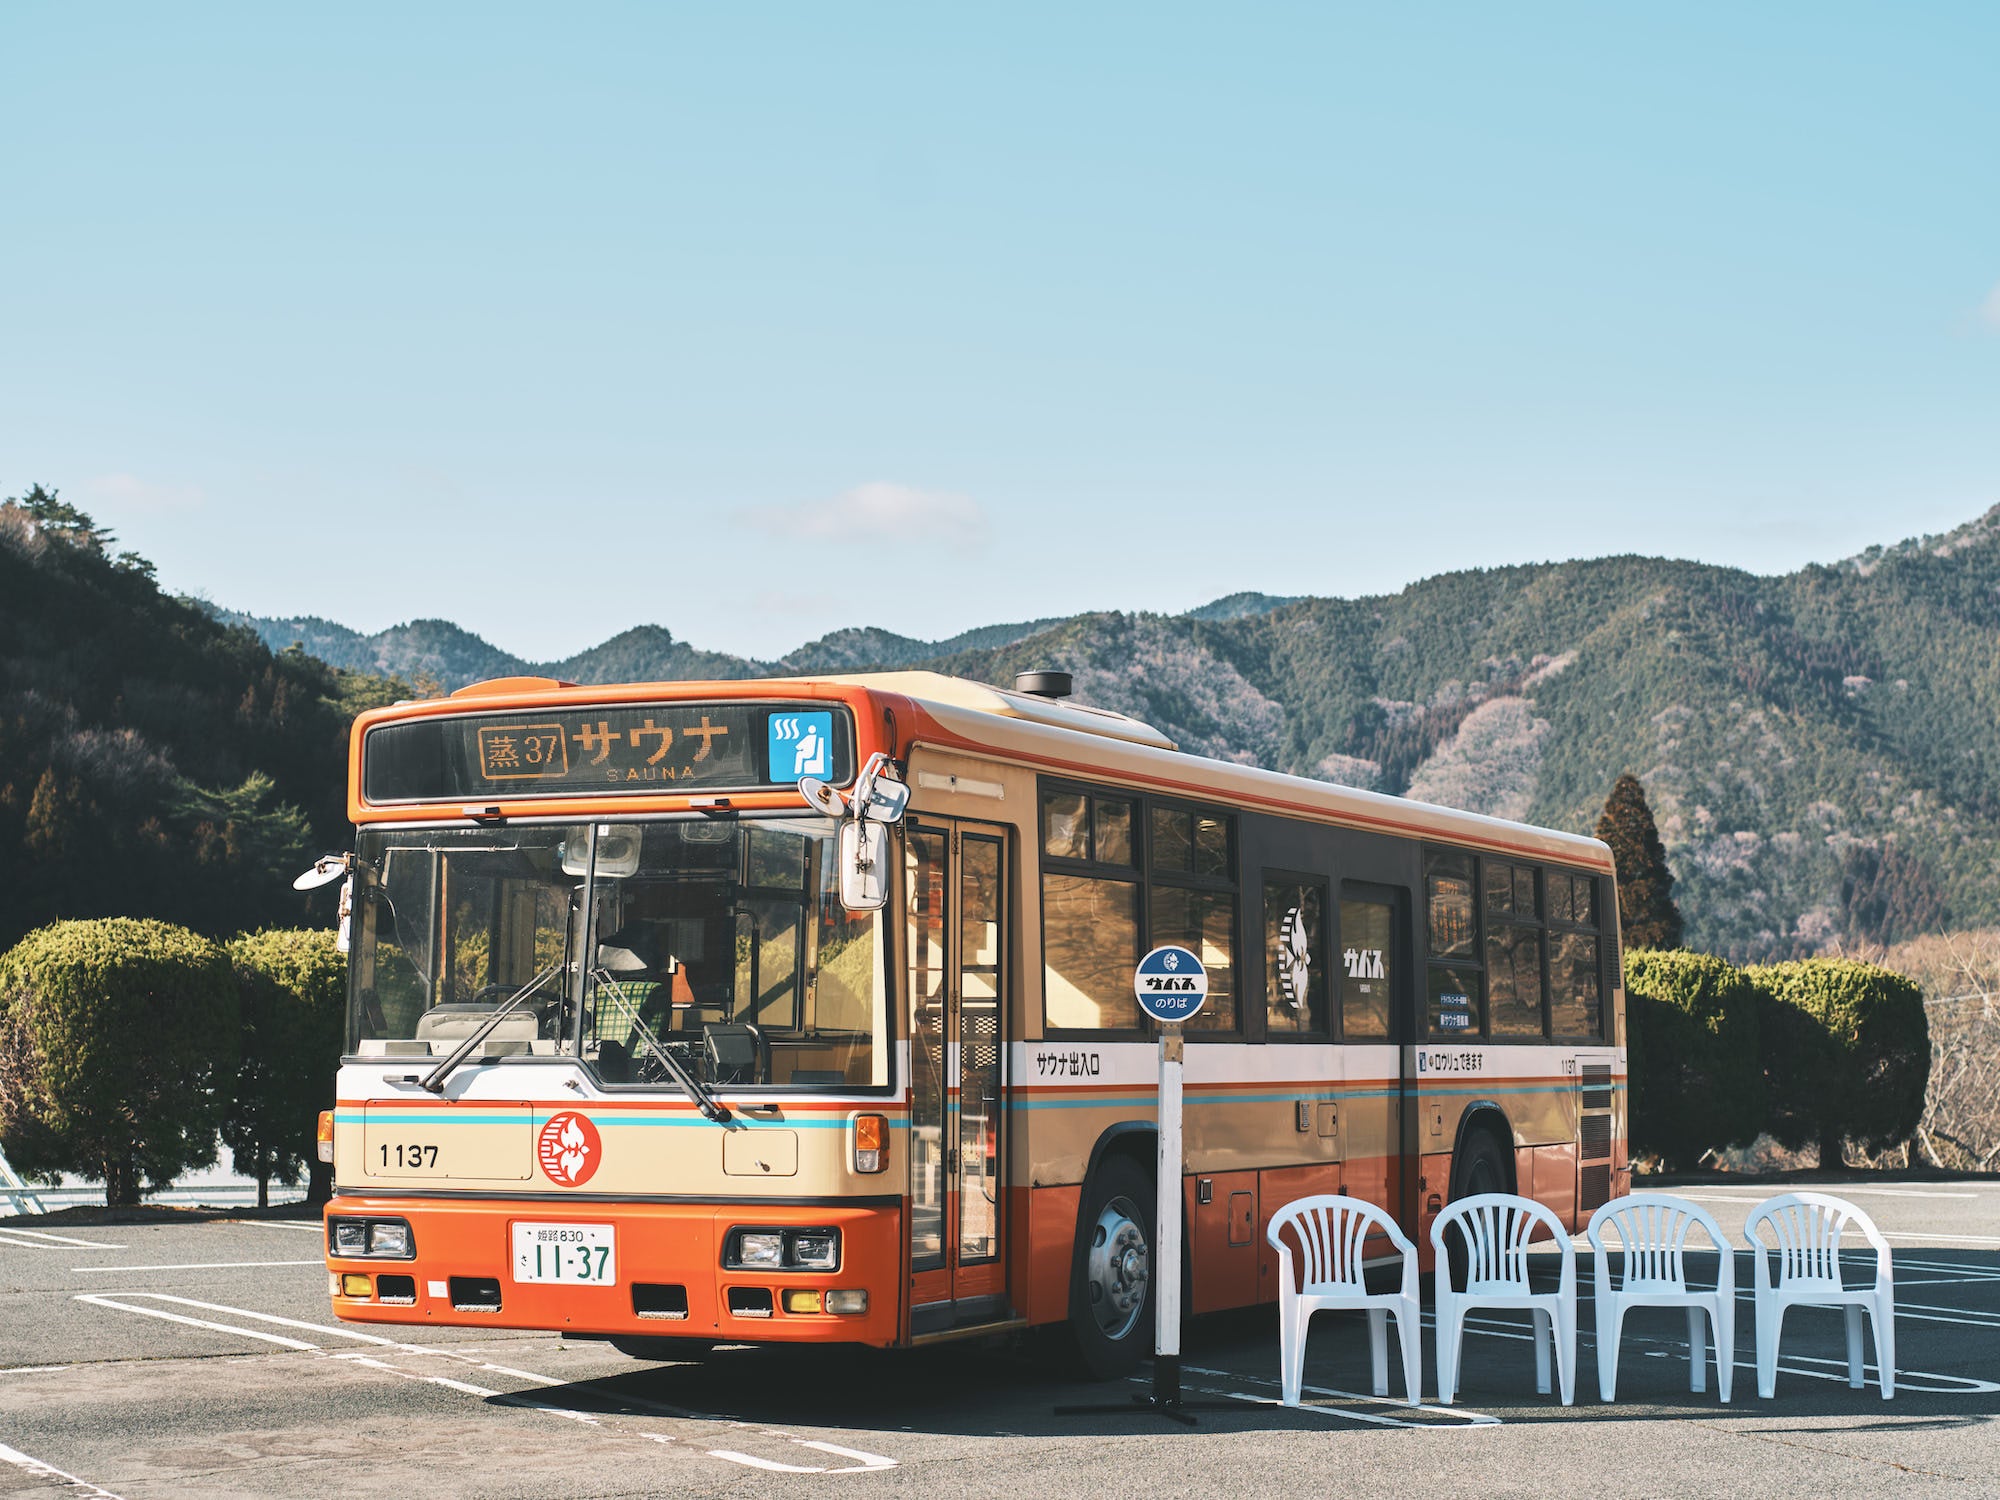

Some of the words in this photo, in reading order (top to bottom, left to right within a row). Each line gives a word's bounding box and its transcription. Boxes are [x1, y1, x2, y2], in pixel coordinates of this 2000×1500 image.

[572, 716, 729, 766] サウナ
[606, 765, 696, 782] SAUNA
[1343, 948, 1385, 979] サバス
[1146, 977, 1196, 990] サバス
[1155, 997, 1188, 1009] のりば
[1036, 1051, 1100, 1076] サウナ出入口
[1435, 1052, 1483, 1071] ロウリュできます
[1561, 1059, 1576, 1075] 1137
[380, 1144, 439, 1168] 1137
[536, 1244, 610, 1280] 11-37
